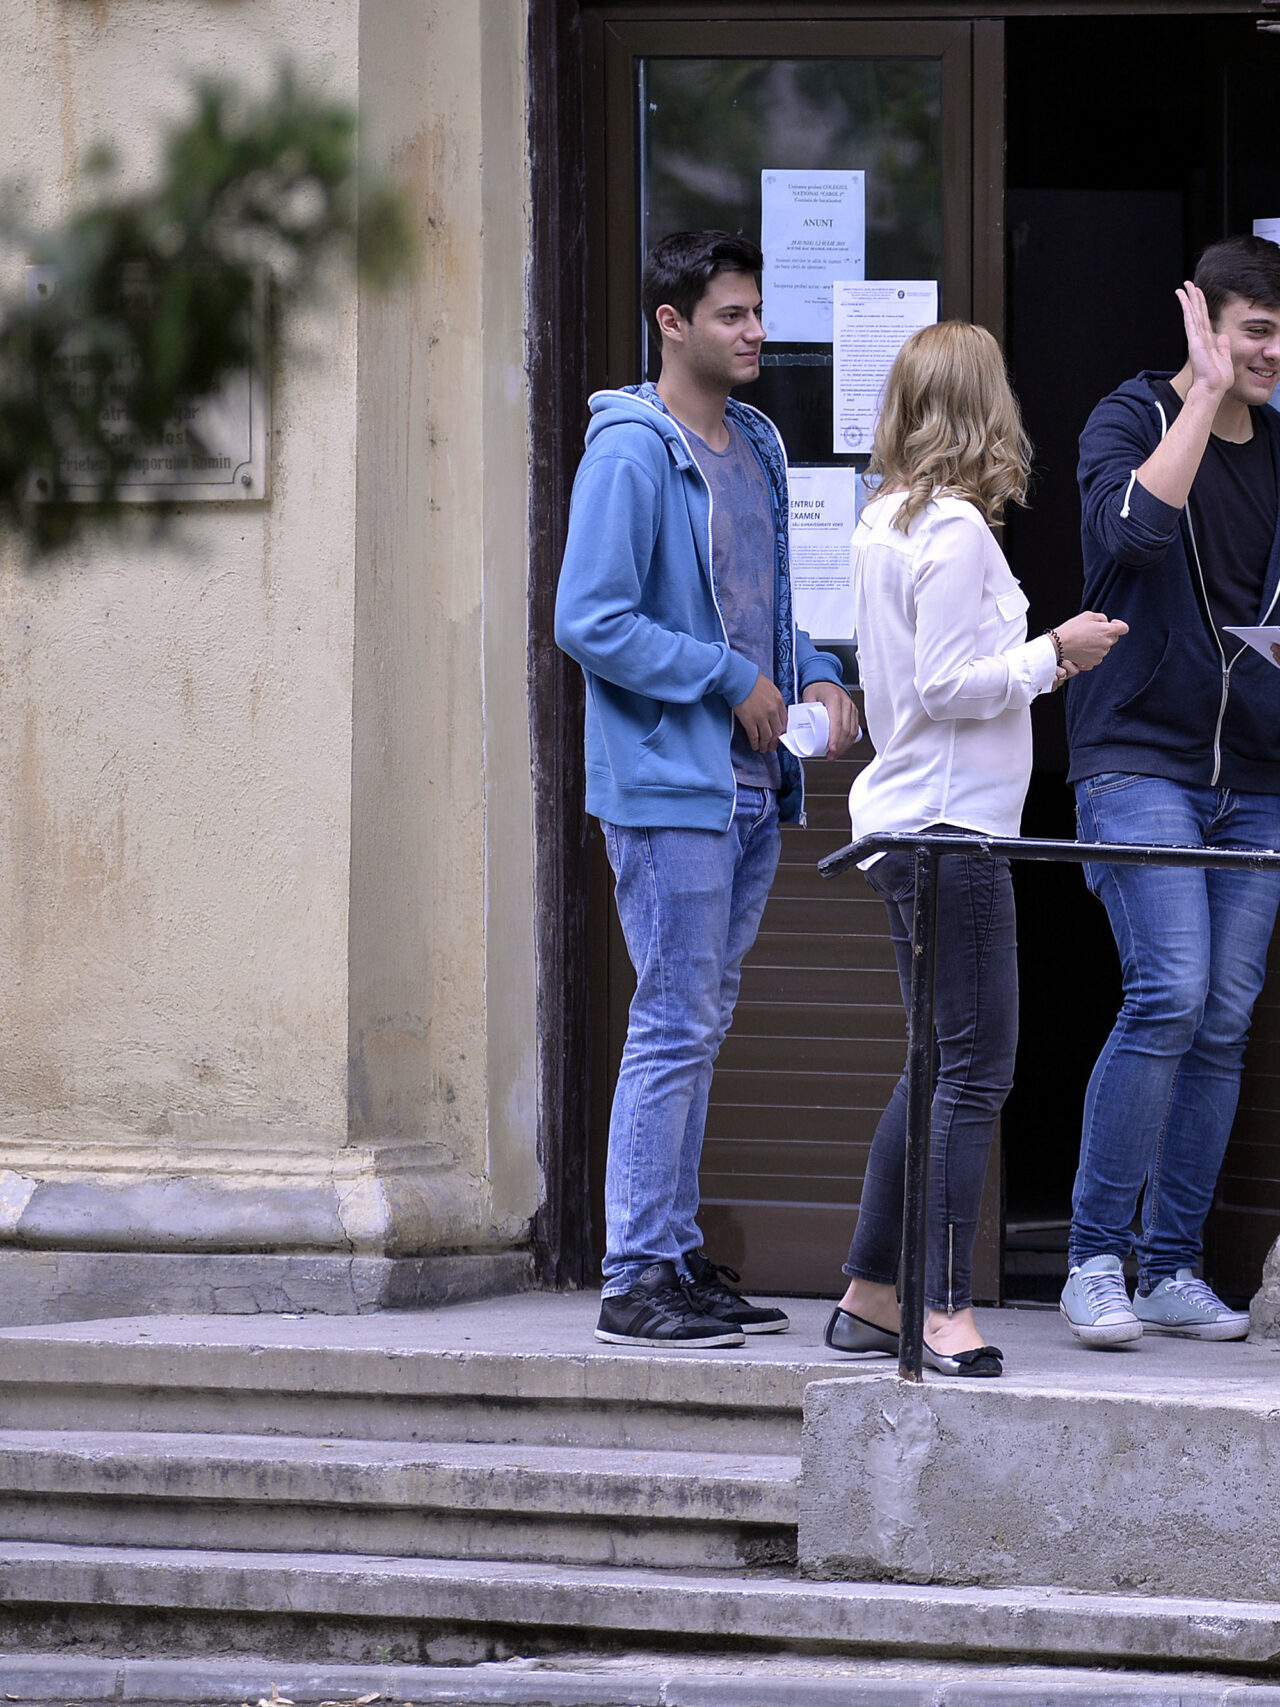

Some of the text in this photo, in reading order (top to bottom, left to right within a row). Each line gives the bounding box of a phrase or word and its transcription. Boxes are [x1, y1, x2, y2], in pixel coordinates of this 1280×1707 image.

[790, 500, 825, 508] ENTRU DE
[790, 512, 821, 520] EXAMEN
